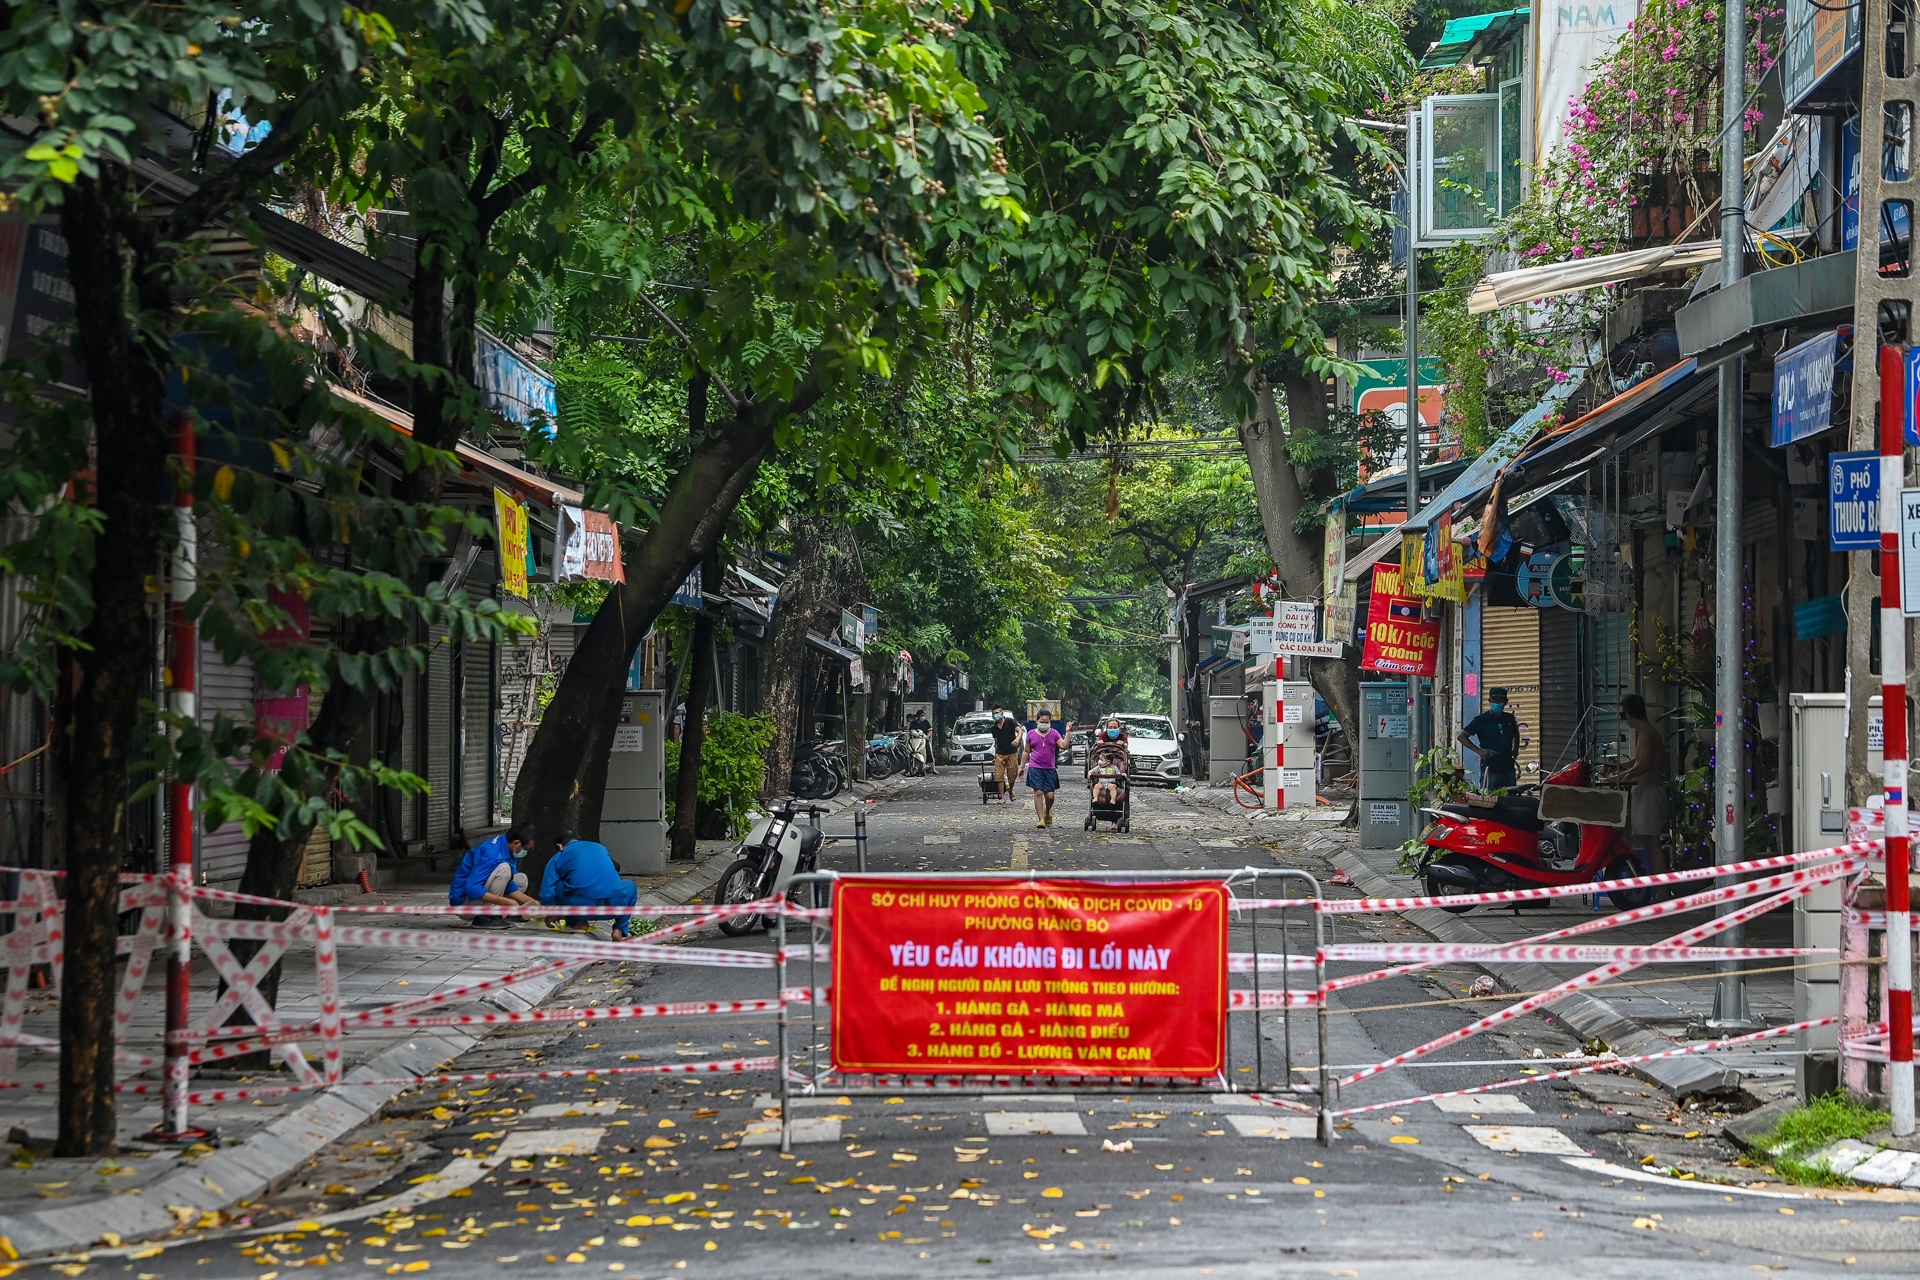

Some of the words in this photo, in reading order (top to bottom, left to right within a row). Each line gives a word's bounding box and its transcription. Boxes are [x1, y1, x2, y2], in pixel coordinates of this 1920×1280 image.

[1558, 4, 1615, 27] NAM
[1850, 463, 1871, 489] PHỐ
[1834, 490, 1865, 533] THUỐC
[1868, 488, 1880, 532] BẮ
[1374, 567, 1400, 596] NƯỚC
[1279, 643, 1295, 651] CÁC
[1297, 645, 1315, 653] LOẠI
[1381, 645, 1423, 661] 700ml
[929, 894, 961, 908] HUY
[964, 892, 1021, 908] PHÒNG
[1083, 897, 1121, 914] DỊCH
[1124, 898, 1172, 911] COVID
[1187, 898, 1203, 911] 19
[965, 913, 1034, 930] PHƯỜNG
[1037, 914, 1083, 931] HÀNG
[889, 940, 930, 967] YÊU
[984, 942, 1057, 969] KHÔNG
[1061, 947, 1083, 970] ĐI
[1089, 941, 1122, 970] LỐI
[1127, 944, 1171, 971] NÀY
[901, 978, 935, 995] NGHỊ
[938, 976, 980, 992] NGƯỜI
[983, 977, 1012, 993] DÂN
[1015, 979, 1042, 993] LƯU
[1044, 978, 1089, 994] THÔNG
[1092, 981, 1126, 995] THEO
[936, 1001, 951, 1015] 1.
[955, 999, 1003, 1015] HÀNG
[1006, 1000, 1030, 1016] GÀ
[1045, 1001, 1092, 1017] HÀNG
[929, 1022, 945, 1036] 2.
[949, 1020, 997, 1037] HÀNG
[1000, 1021, 1024, 1037] GÀ
[1040, 1022, 1087, 1038] HÀNG
[907, 1043, 923, 1057] 3.
[927, 1042, 974, 1058] HÀNG
[1018, 1044, 1073, 1059] LƯƠNG
[1077, 1045, 1112, 1060] VĂN
[1116, 1047, 1152, 1060] CAN
